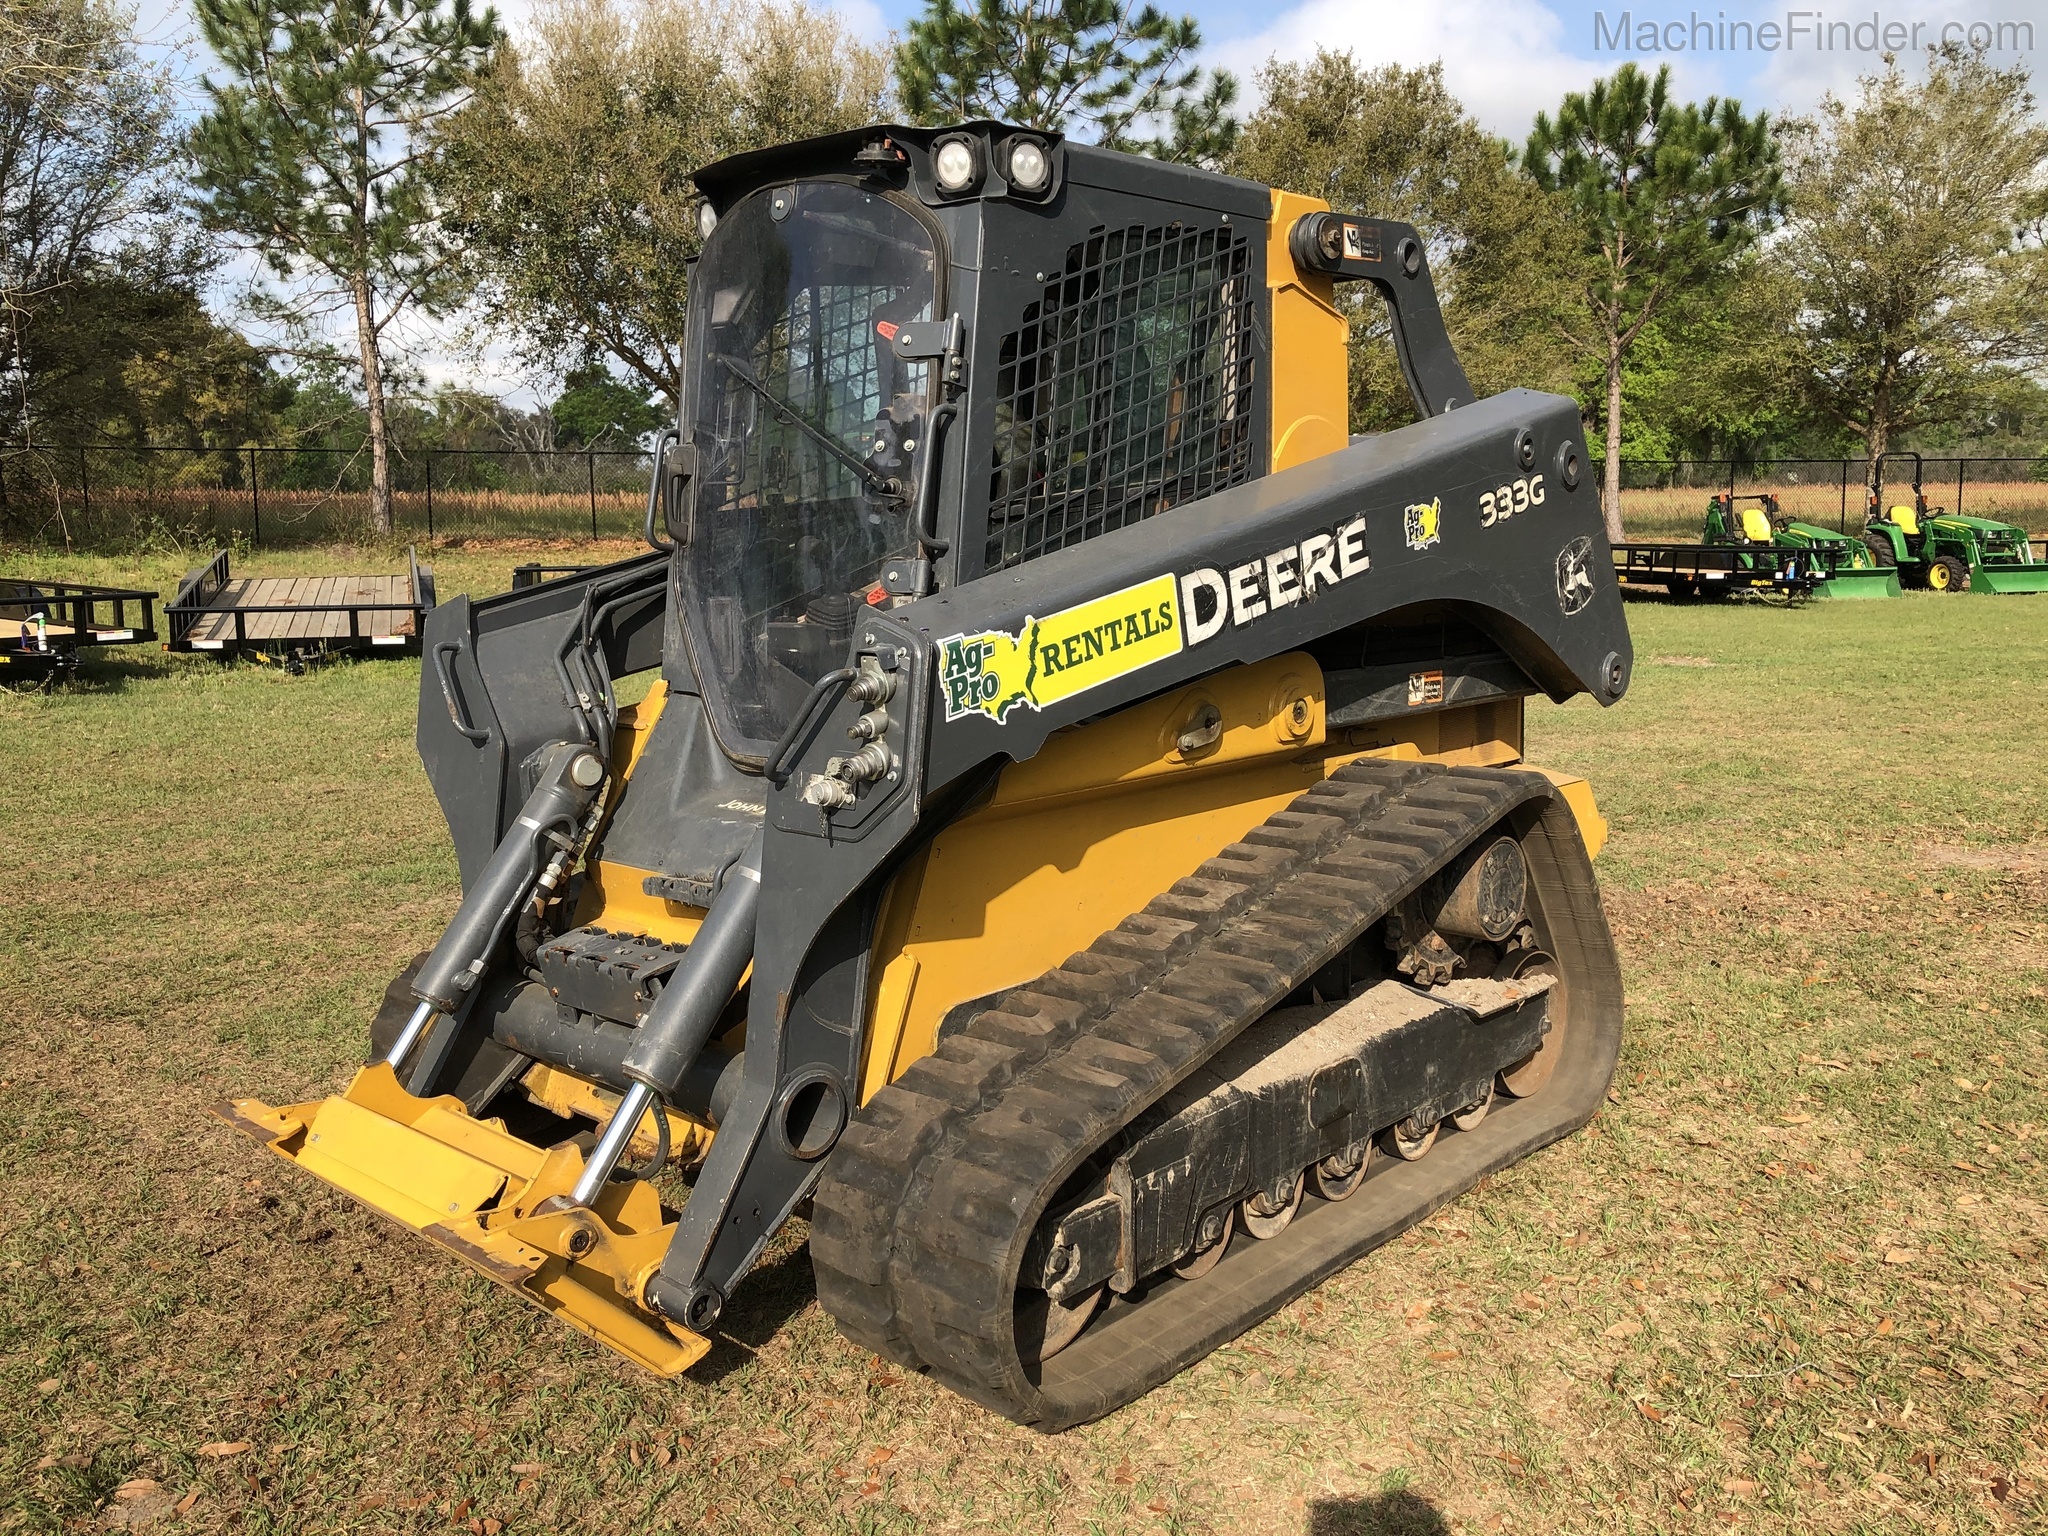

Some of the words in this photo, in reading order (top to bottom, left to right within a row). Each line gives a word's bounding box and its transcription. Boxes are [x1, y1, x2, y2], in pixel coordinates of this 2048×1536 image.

[1479, 474, 1545, 528] 333G
[1408, 525, 1425, 543] Pro
[1180, 517, 1370, 647] DEERE
[945, 639, 993, 679] Ag-
[1039, 601, 1173, 677] RENTALS
[948, 674, 999, 713] Pro
[717, 799, 765, 812] JOHN
